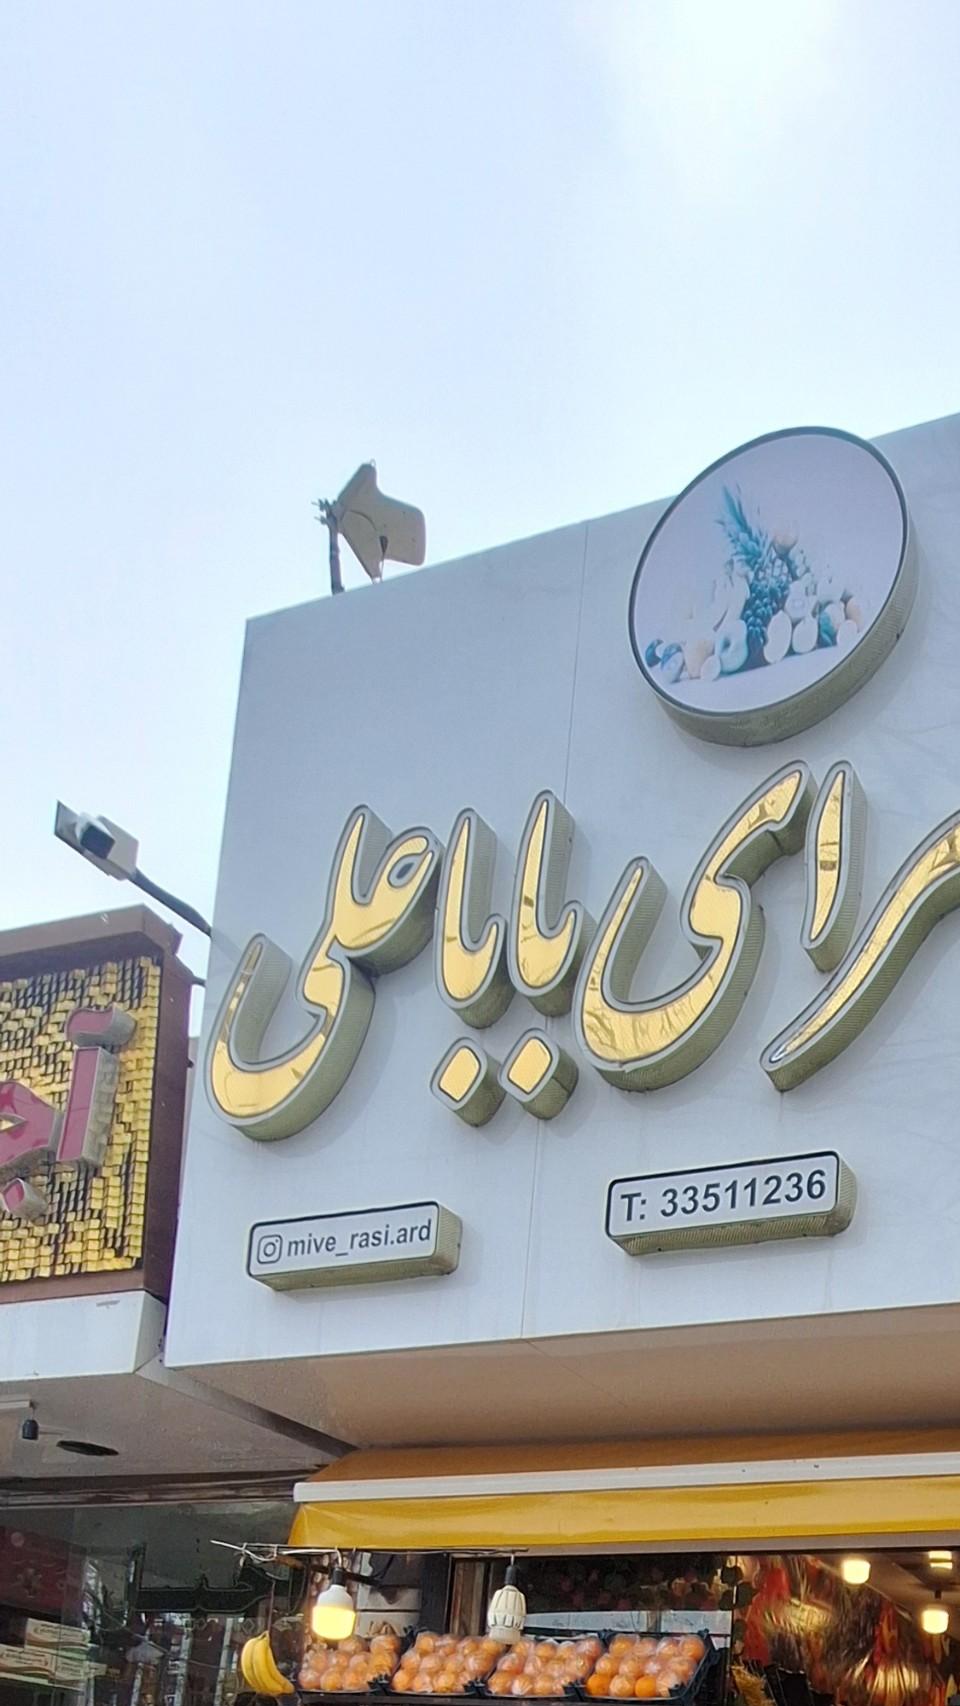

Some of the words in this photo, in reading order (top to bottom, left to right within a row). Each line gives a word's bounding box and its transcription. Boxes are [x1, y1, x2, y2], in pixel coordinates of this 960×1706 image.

[621, 1192, 647, 1222] T:
[660, 1169, 826, 1218] 33511236
[287, 1218, 431, 1257] mive_rasi.ard
